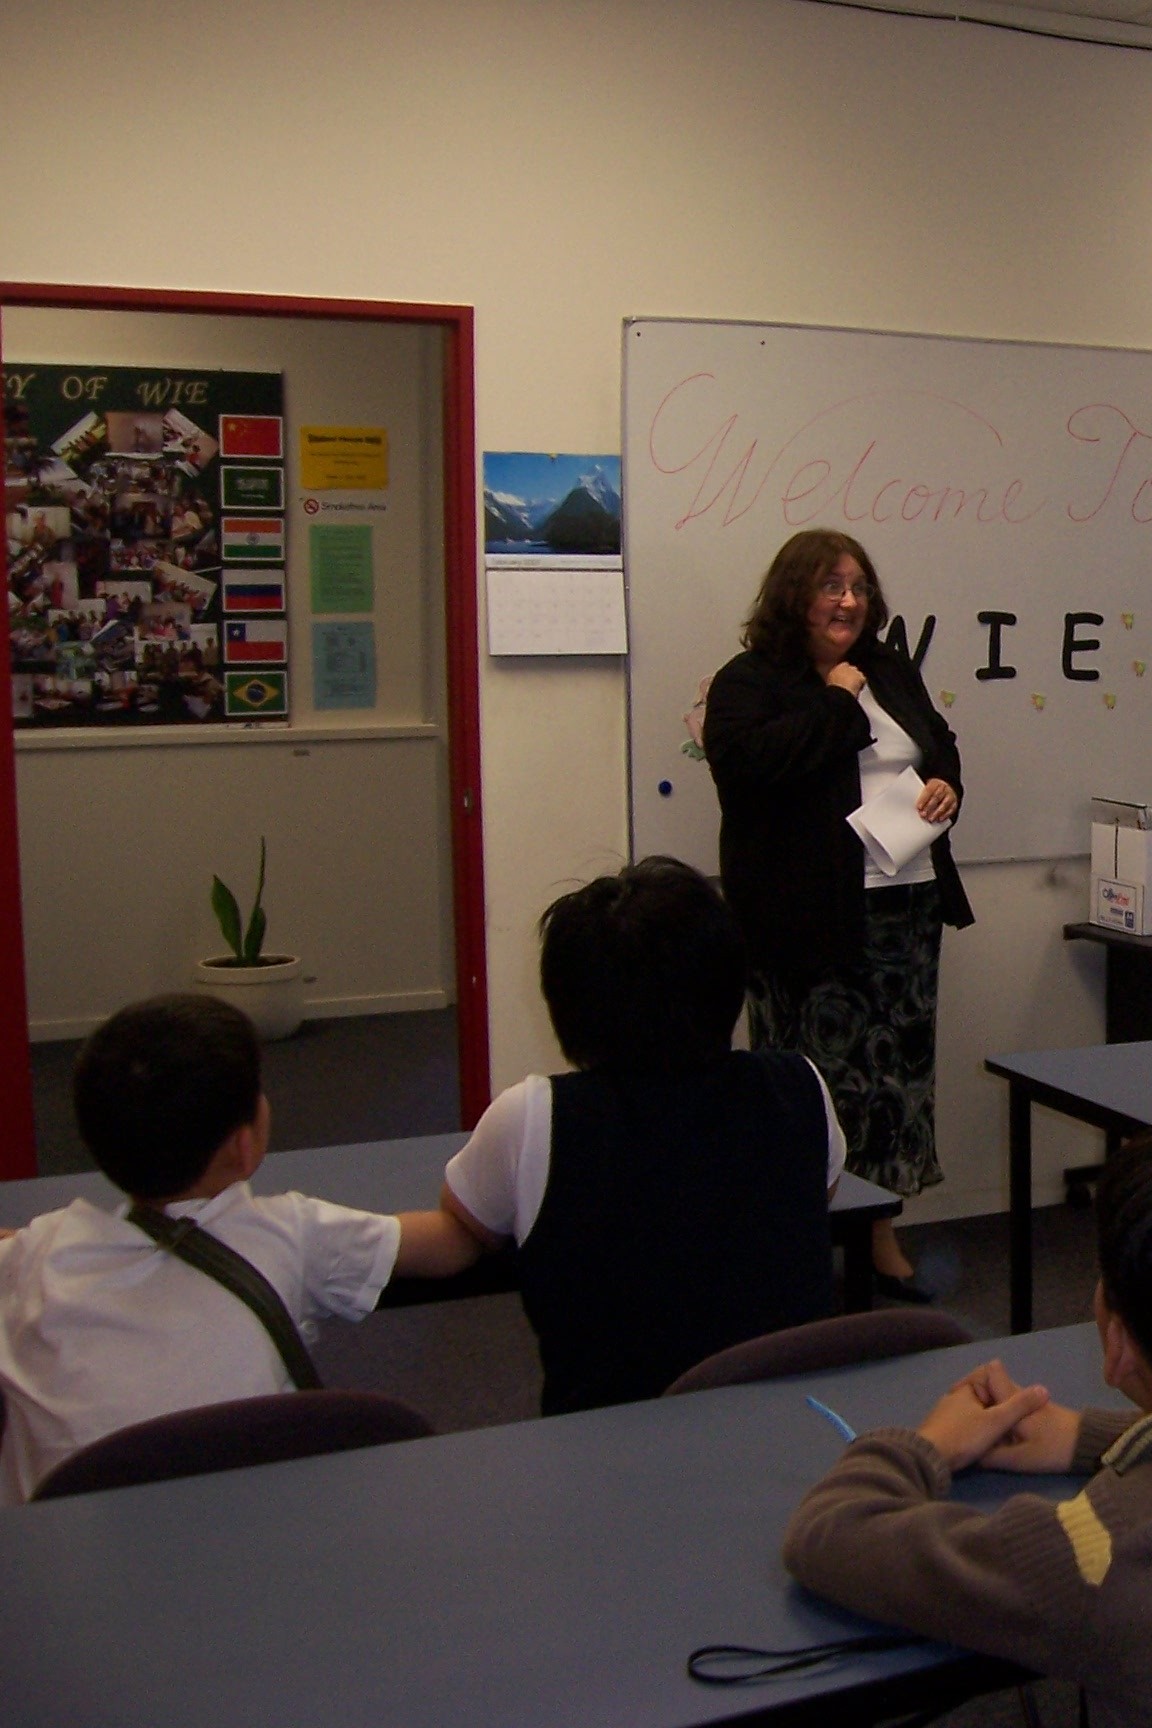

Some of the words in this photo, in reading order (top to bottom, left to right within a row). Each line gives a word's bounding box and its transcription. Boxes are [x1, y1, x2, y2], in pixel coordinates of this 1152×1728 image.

[62, 376, 108, 401] OF
[136, 376, 209, 406] WIE
[650, 373, 1048, 531] Welcome
